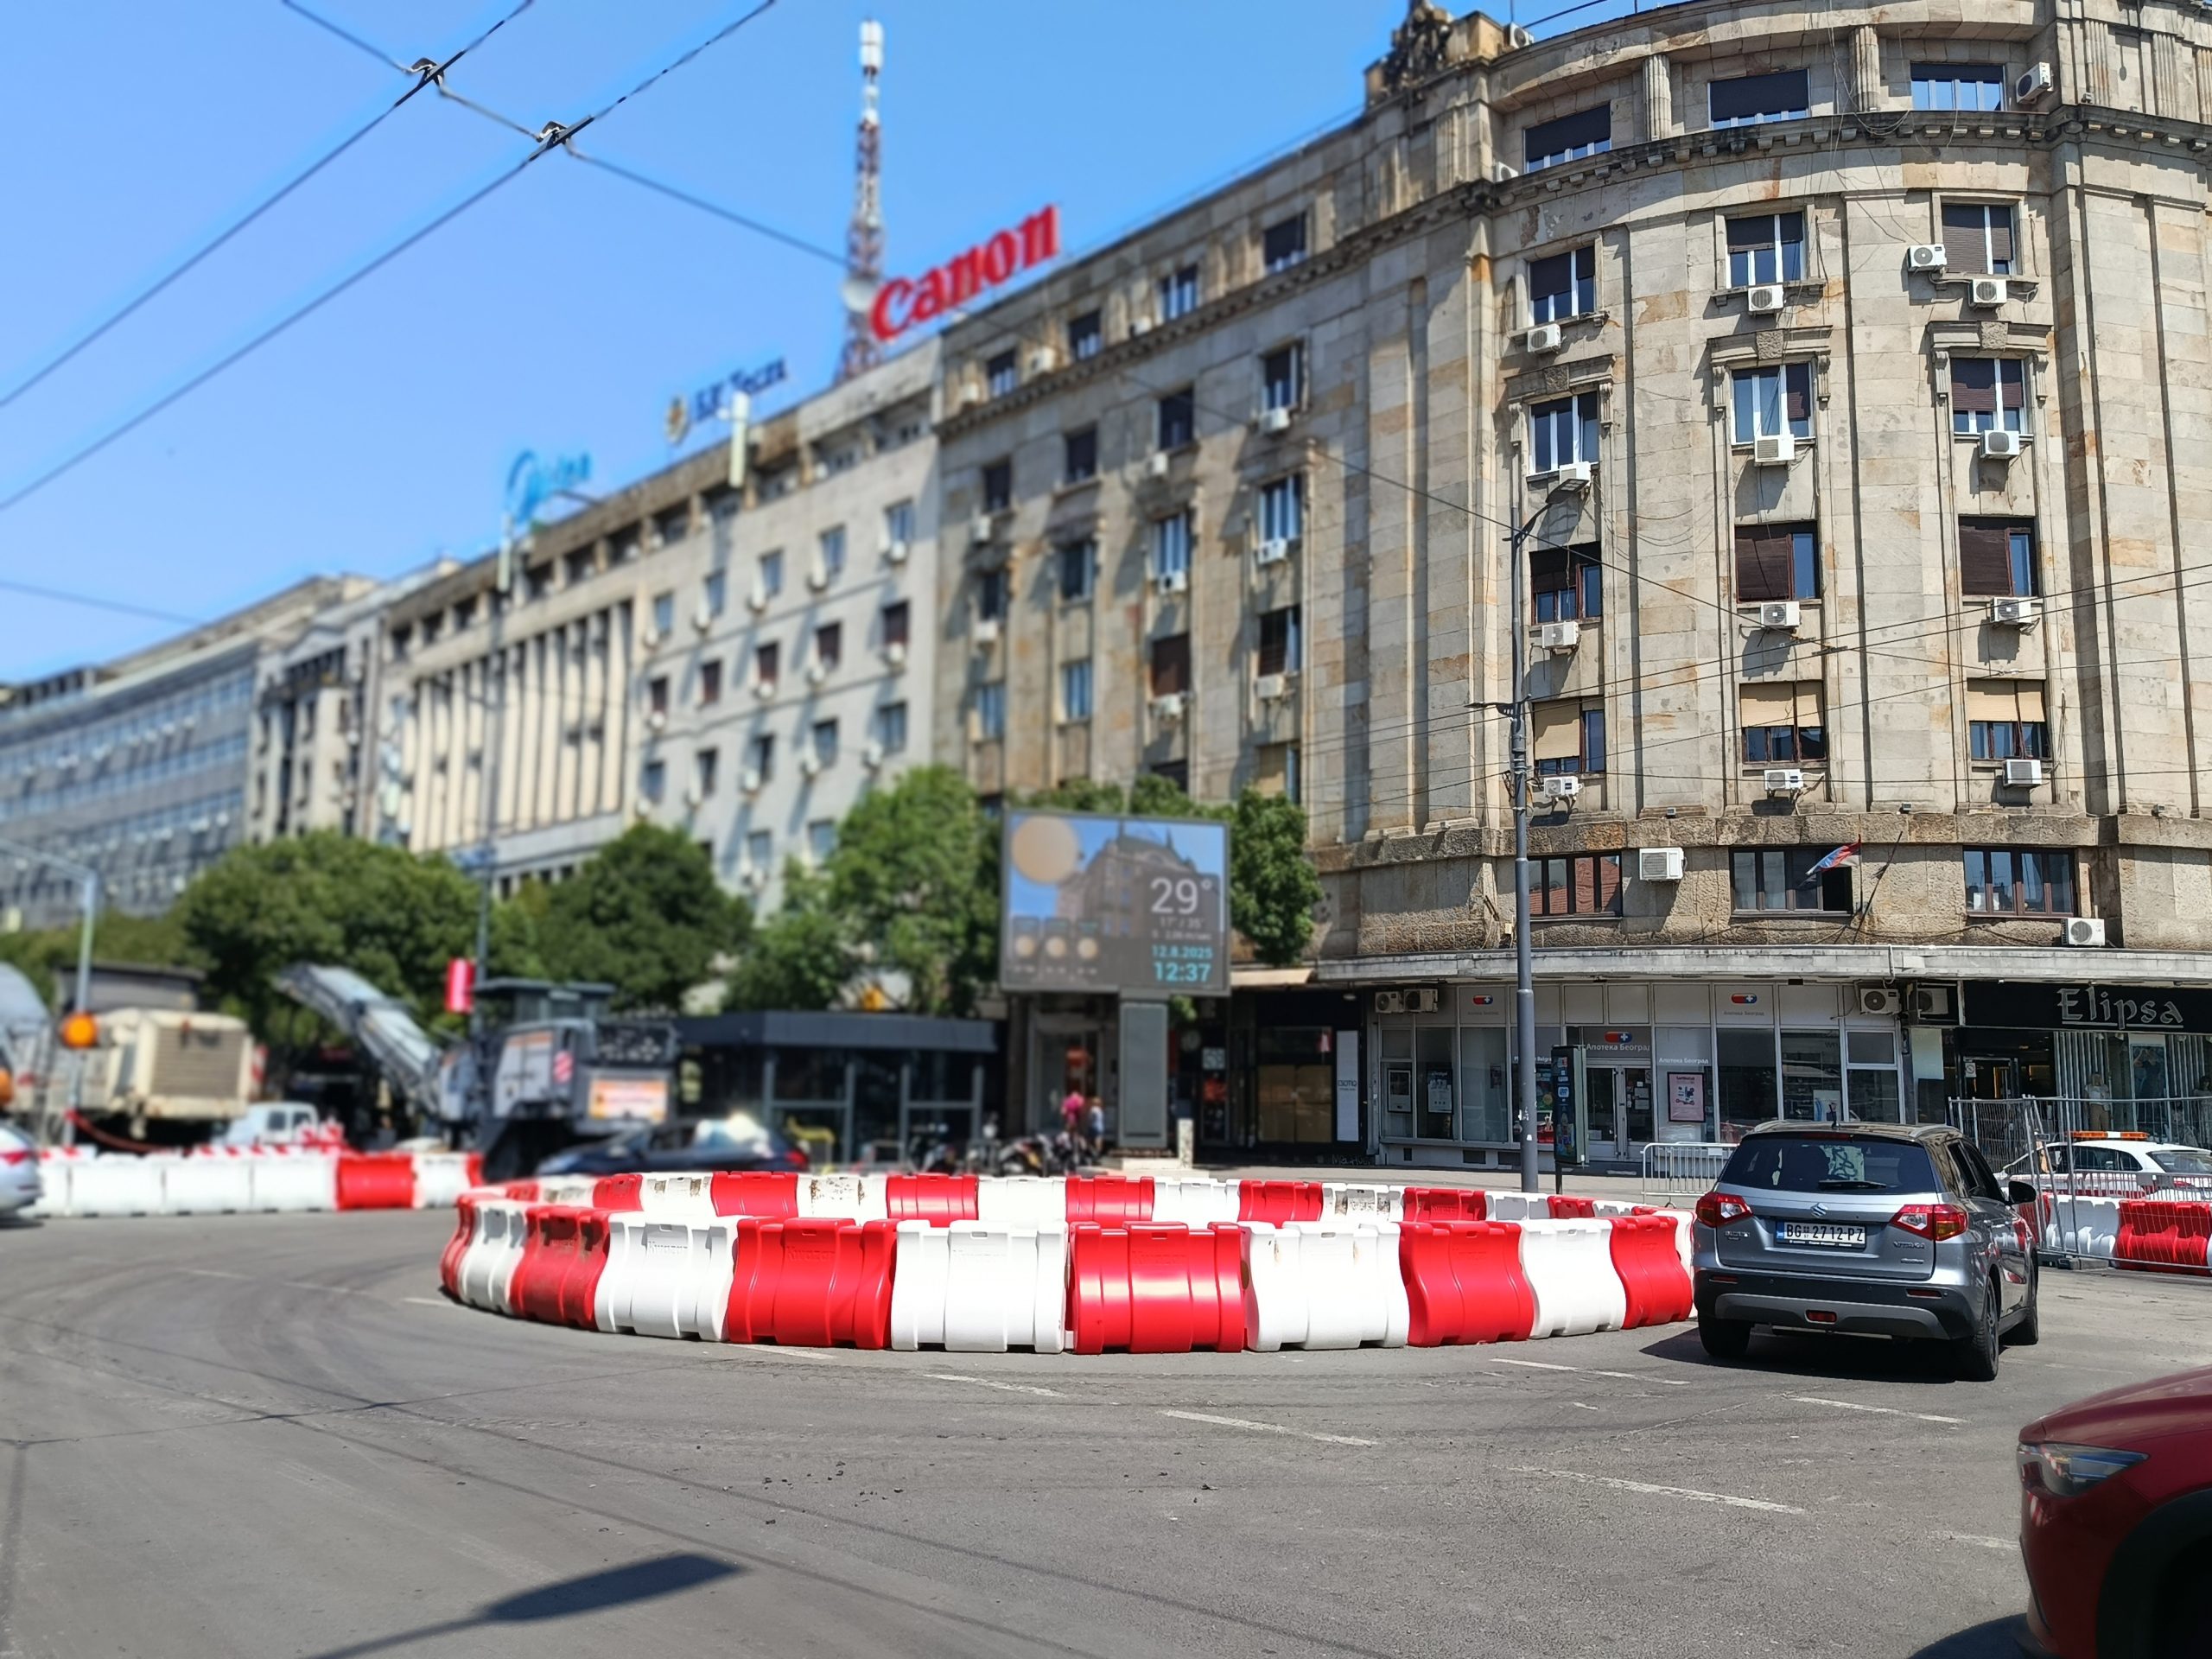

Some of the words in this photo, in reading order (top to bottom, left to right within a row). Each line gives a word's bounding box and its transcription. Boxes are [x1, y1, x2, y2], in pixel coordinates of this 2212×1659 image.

[870, 204, 1059, 342] Canon
[1154, 961, 1211, 982] 12:37
[2056, 986, 2183, 1030] Elipsa
[1683, 1057, 1709, 1065] Београд
[1786, 1224, 1802, 1237] BG
